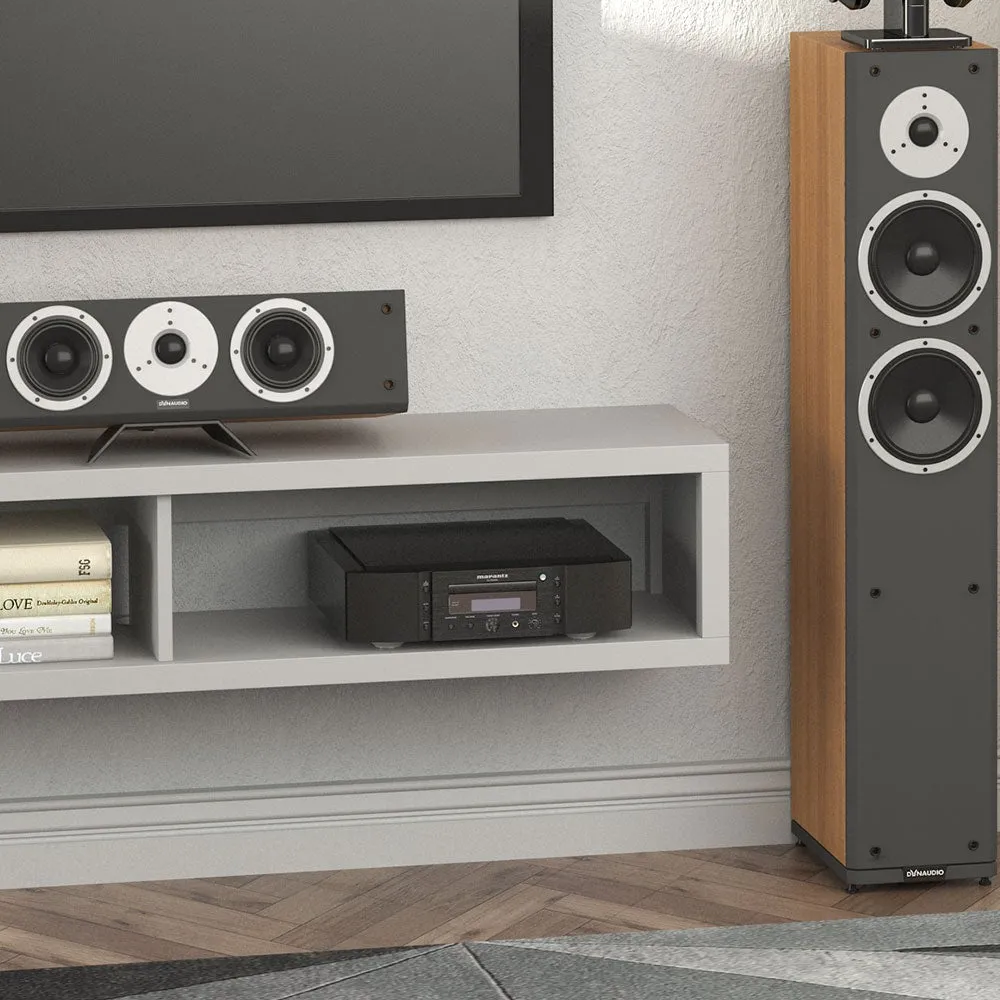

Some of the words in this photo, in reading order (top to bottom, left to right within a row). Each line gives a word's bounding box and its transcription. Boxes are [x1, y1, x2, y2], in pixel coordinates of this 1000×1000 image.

[78, 558, 91, 576] FSG
[0, 598, 33, 611] OVE
[906, 869, 945, 878] DYNAUDIO
